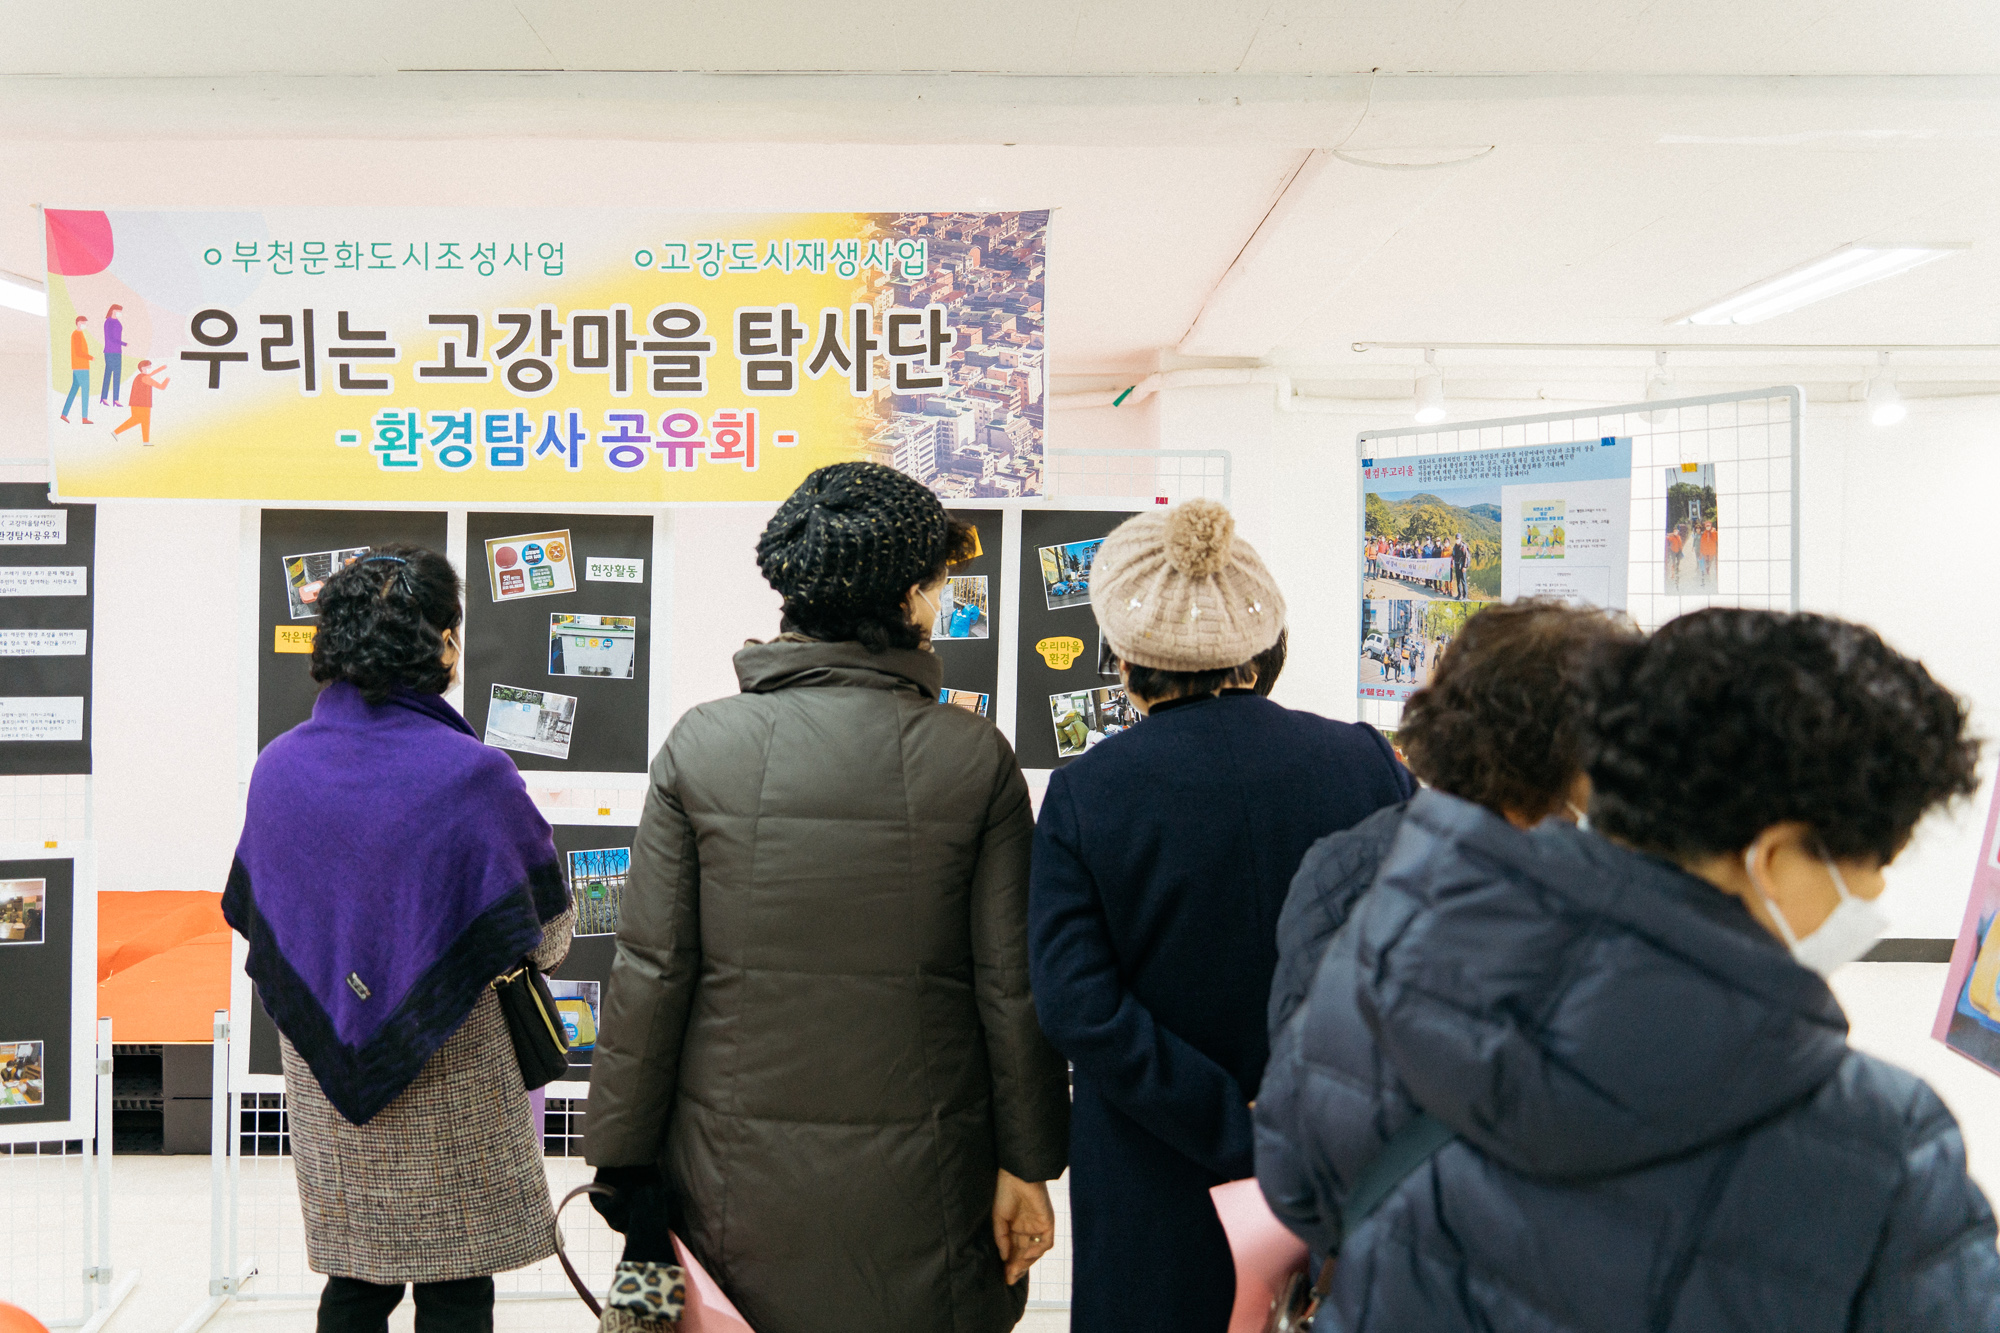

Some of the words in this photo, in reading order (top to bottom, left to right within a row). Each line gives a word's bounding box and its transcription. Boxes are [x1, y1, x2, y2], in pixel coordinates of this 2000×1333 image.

[180, 308, 396, 391] 우리는
[419, 308, 711, 392] 고강마을
[739, 308, 952, 391] 탐사단
[373, 412, 586, 467] 환경탐사
[601, 412, 756, 468] 공유회
[1364, 465, 1415, 480] 웰컴투고리울
[590, 563, 638, 578] 현장활동
[1038, 640, 1082, 653] 우리마을
[1049, 653, 1071, 665] 환경
